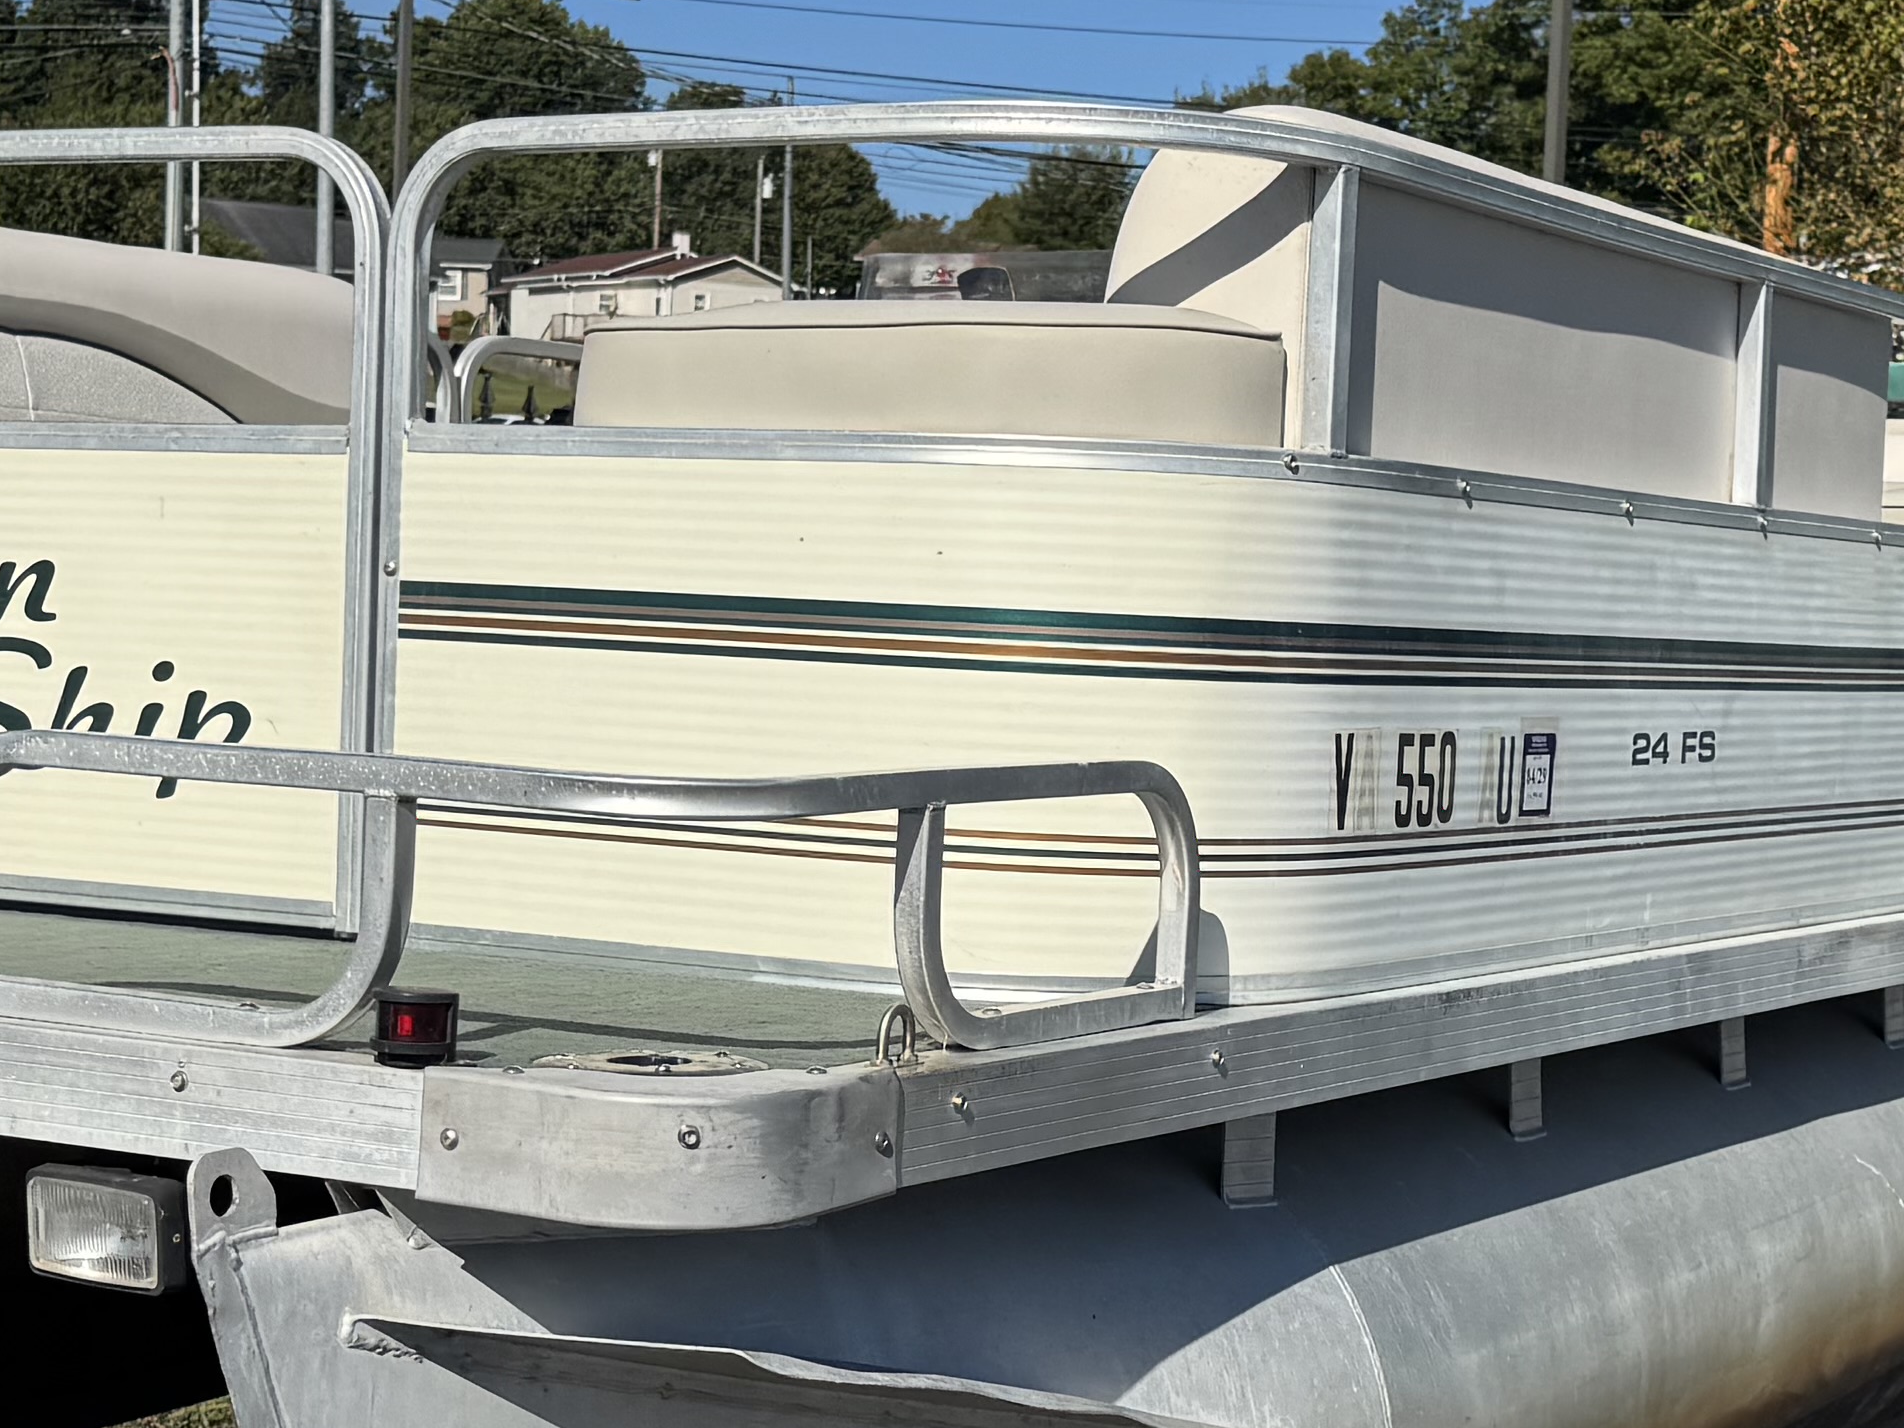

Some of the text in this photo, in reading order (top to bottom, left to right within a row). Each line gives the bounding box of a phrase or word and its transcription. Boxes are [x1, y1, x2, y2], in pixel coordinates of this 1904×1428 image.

[1395, 731, 1456, 828] 550
[1632, 731, 1715, 766] 24 FS
